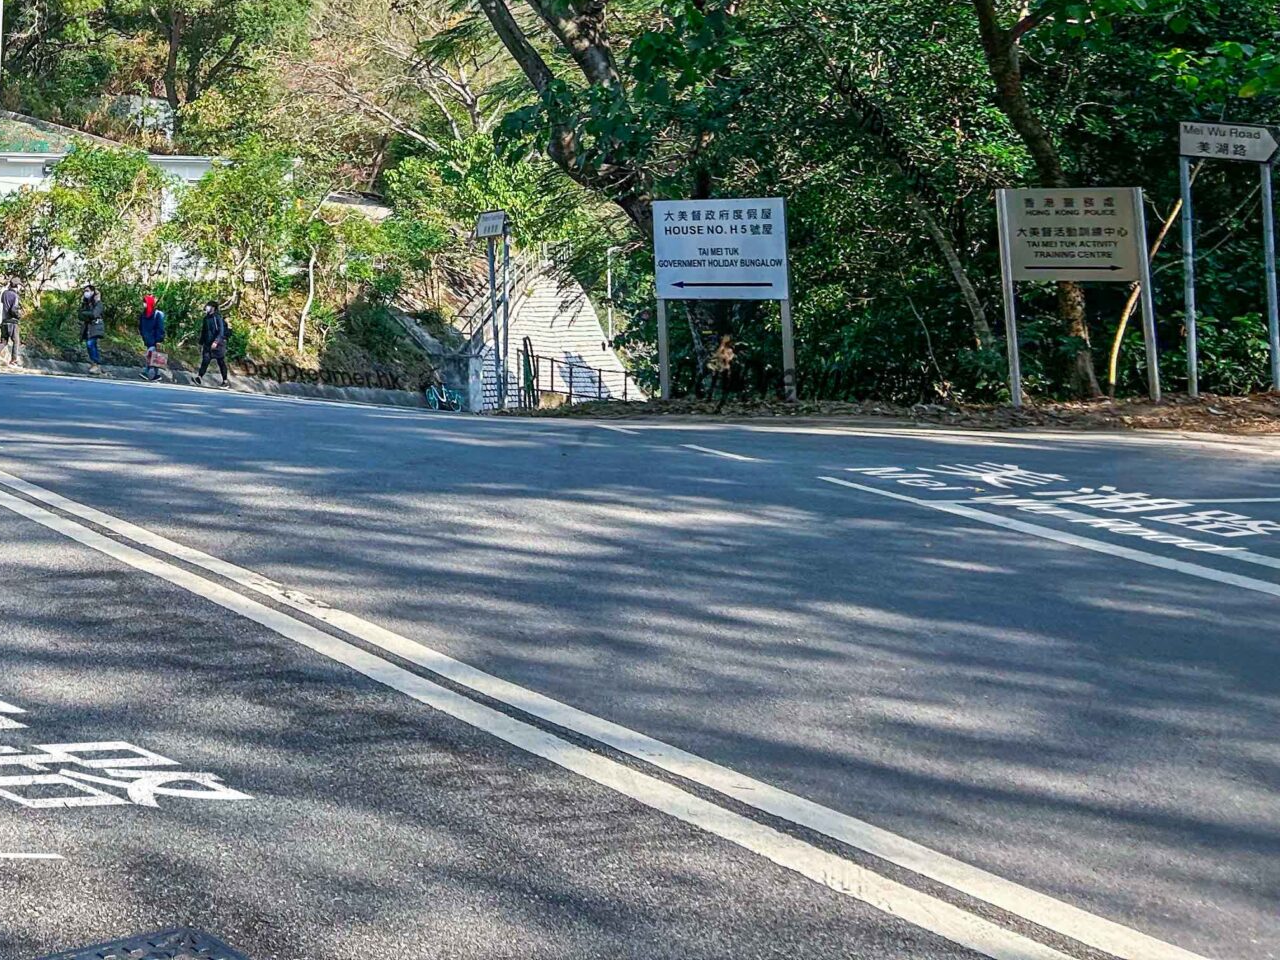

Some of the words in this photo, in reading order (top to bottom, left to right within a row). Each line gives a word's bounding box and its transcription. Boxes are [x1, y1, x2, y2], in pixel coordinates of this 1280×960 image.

[1183, 124, 1204, 135] Mei
[1208, 127, 1226, 137] Wu
[1230, 128, 1261, 140] Road
[664, 225, 705, 235] HOUSE
[706, 225, 728, 235] NO.
[730, 224, 738, 234] H
[740, 224, 747, 234] 5
[698, 248, 709, 256] TAI
[710, 248, 723, 256] MEI
[725, 247, 739, 256] TUK
[1077, 251, 1113, 259] CENTRE
[658, 260, 707, 268] GOVERNMENT
[707, 259, 739, 267] HOLIDAY
[740, 258, 783, 268] BUNGALOW
